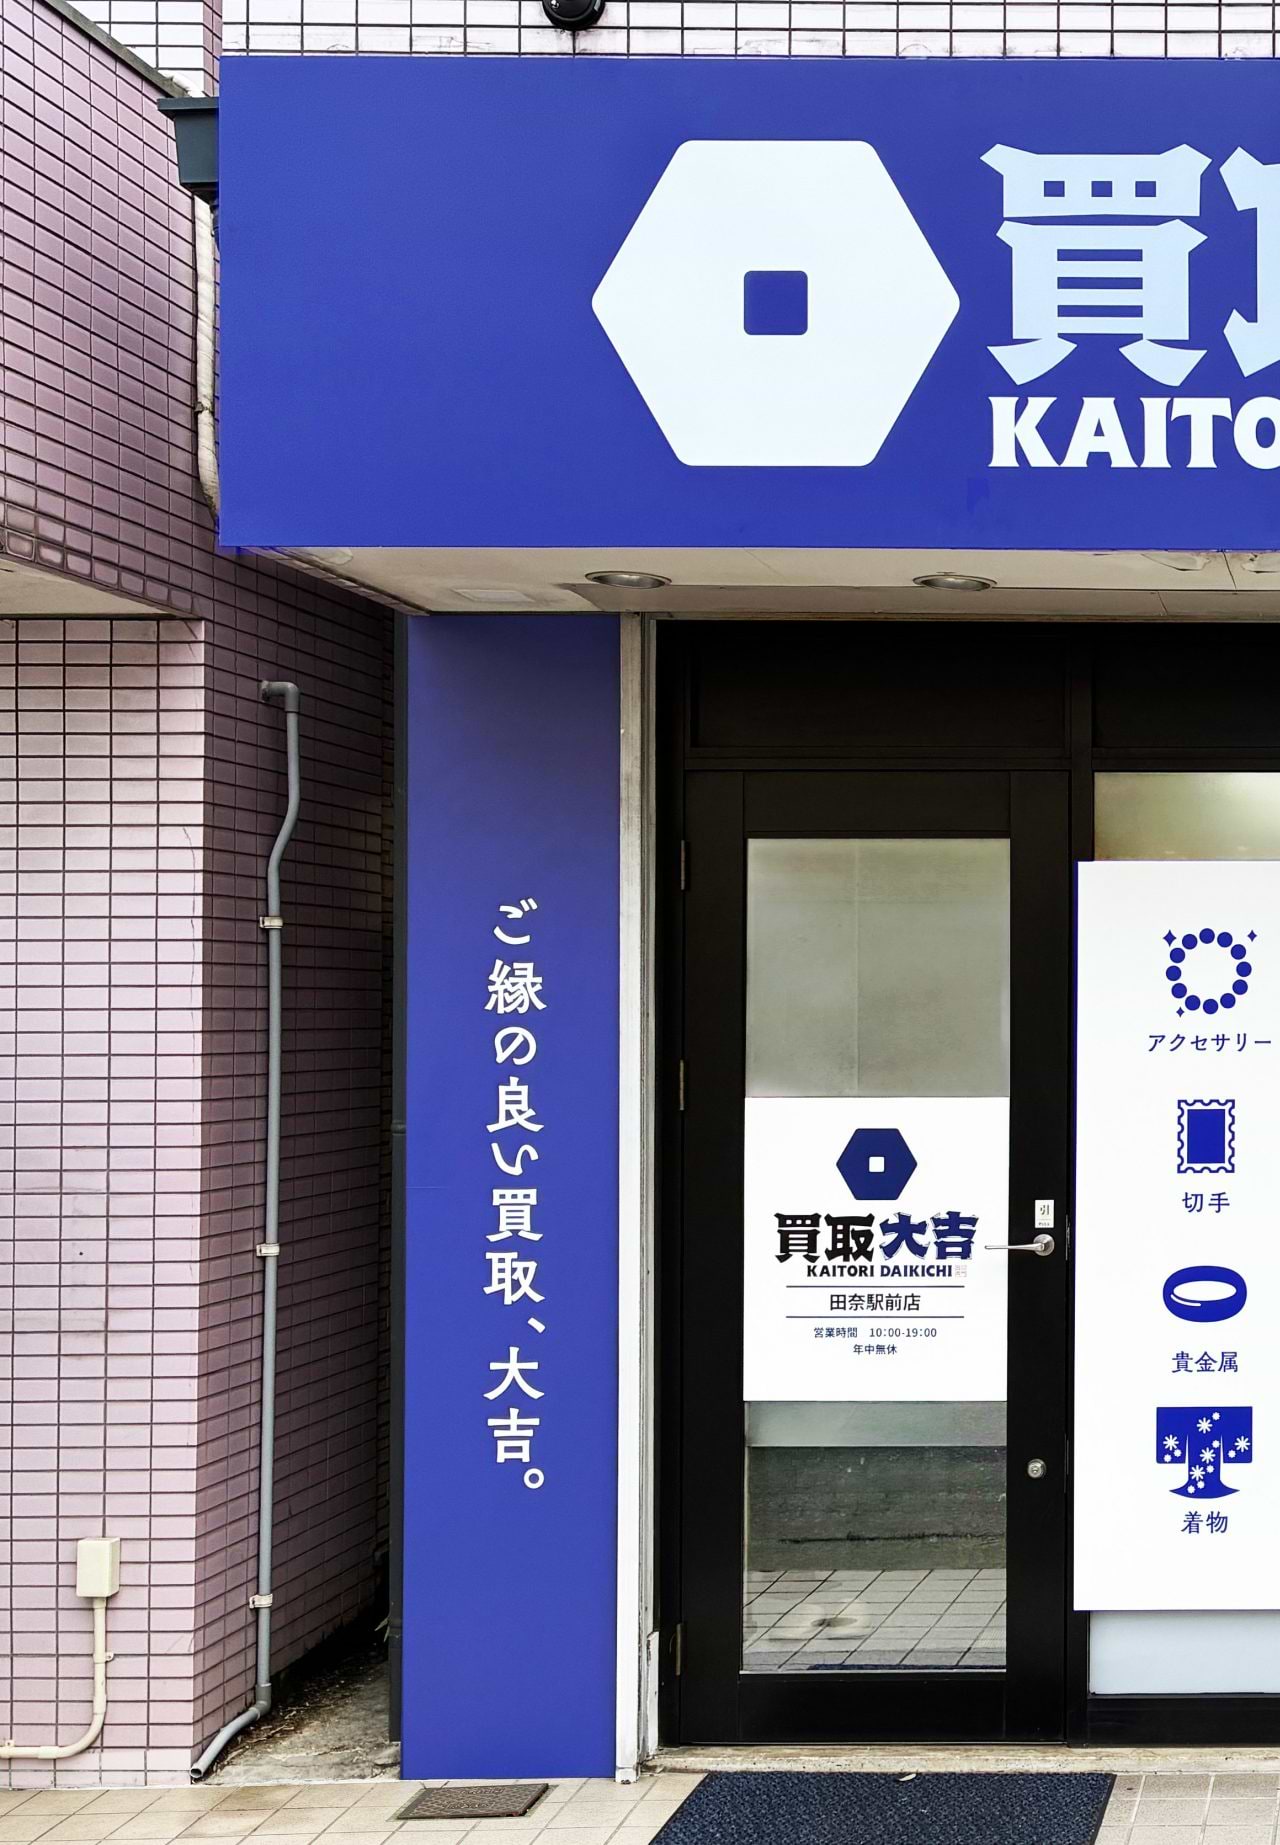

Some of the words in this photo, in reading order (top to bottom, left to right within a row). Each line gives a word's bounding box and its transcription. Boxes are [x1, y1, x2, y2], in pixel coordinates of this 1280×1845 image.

[1148, 1032, 1272, 1052] アクセサリー
[482, 897, 547, 1490] ご縁の良い買取、大吉。
[1181, 1191, 1231, 1214] 切手
[774, 1210, 980, 1263] 買取大吉
[807, 1264, 875, 1278] KAITORI
[880, 1264, 953, 1278] DAIKICHI
[829, 1293, 921, 1312] 田奈駅前店
[813, 1327, 858, 1339] 営業時間
[869, 1328, 938, 1339] 10:00-19:00
[853, 1343, 898, 1356] 年中無休
[1171, 1350, 1239, 1374] 貴金属
[1180, 1510, 1229, 1535] 着物
